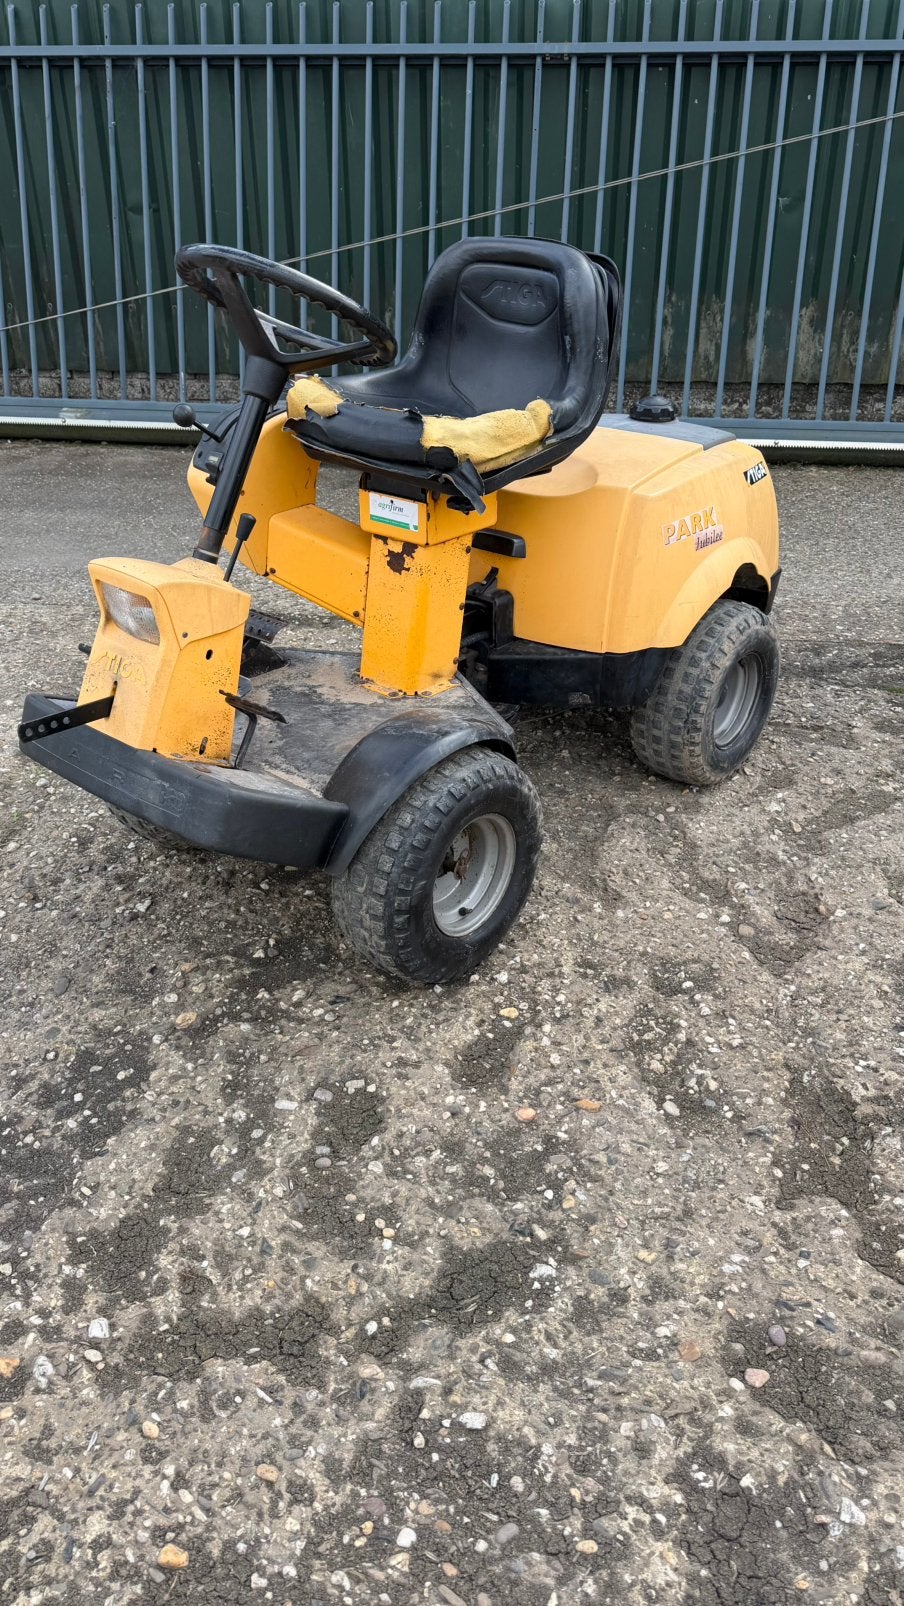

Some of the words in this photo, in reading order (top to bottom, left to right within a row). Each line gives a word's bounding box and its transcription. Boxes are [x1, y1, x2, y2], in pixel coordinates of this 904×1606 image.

[747, 463, 766, 485] STIGA
[664, 507, 716, 545] PARK
[696, 530, 723, 551] Jubilee
